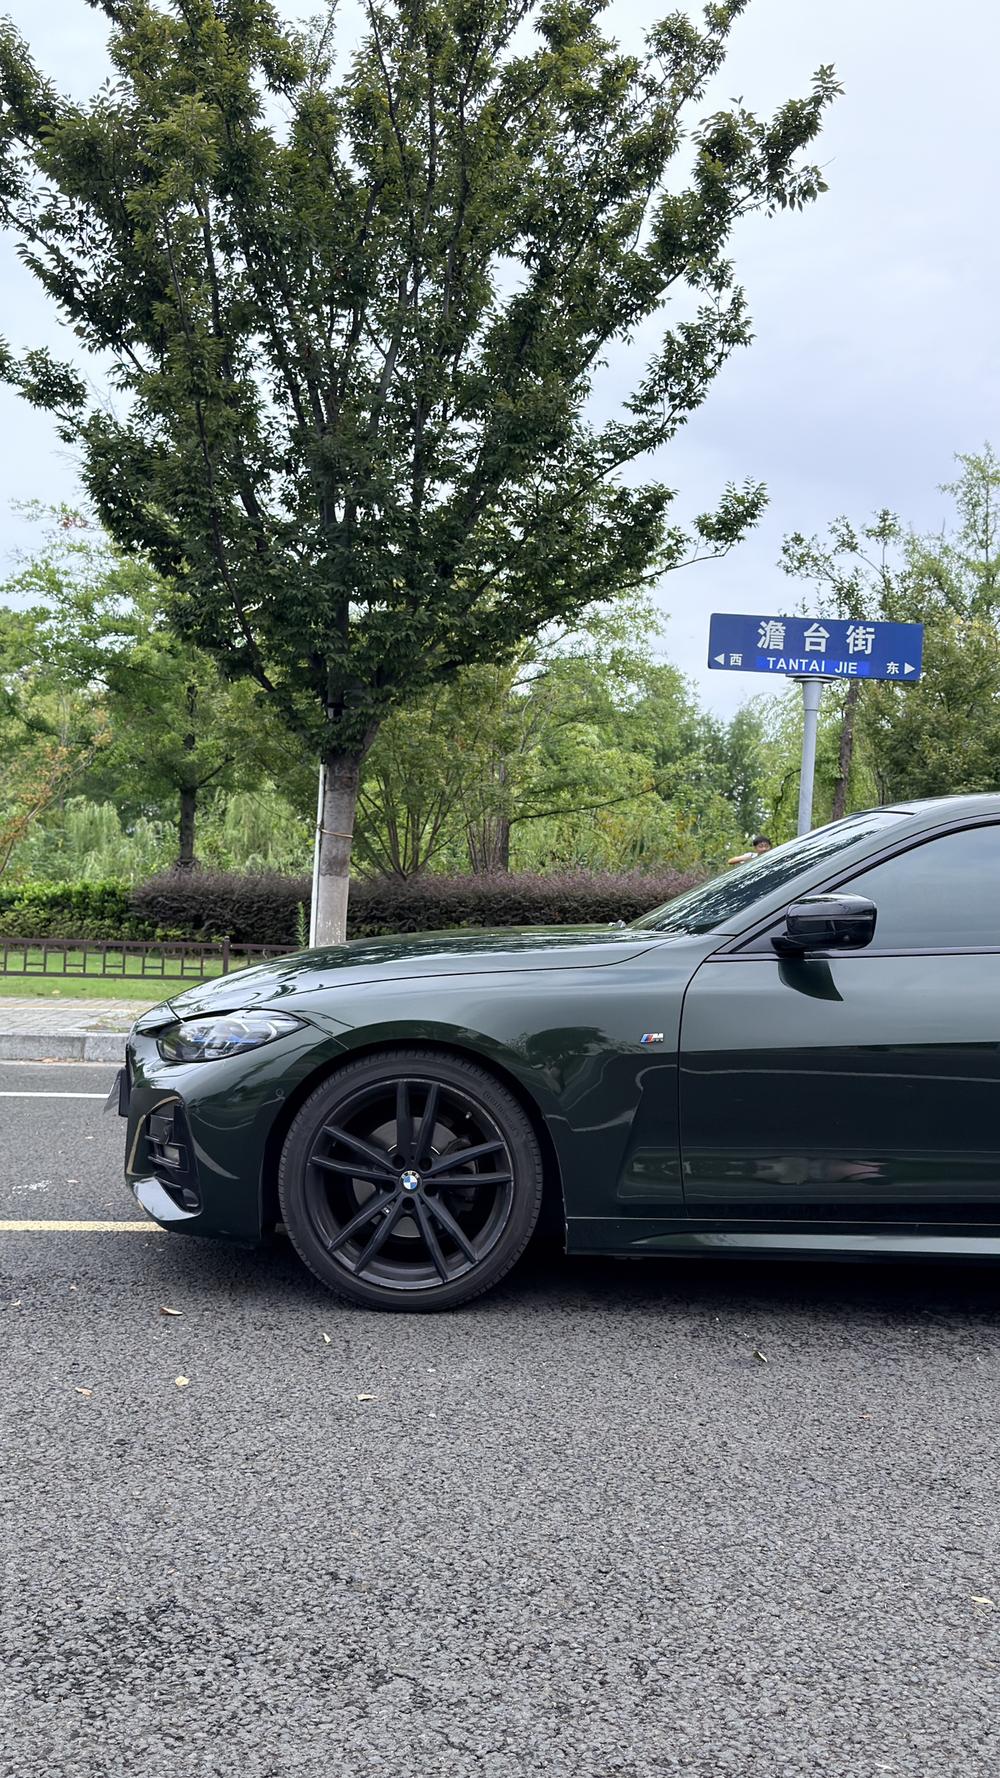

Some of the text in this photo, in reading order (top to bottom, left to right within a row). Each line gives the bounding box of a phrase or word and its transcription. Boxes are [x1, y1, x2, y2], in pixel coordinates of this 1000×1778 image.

[756, 620, 876, 655] 澹台街
[729, 653, 743, 666] 西
[767, 657, 858, 675] TANTAI JIE
[886, 661, 900, 675] 东
